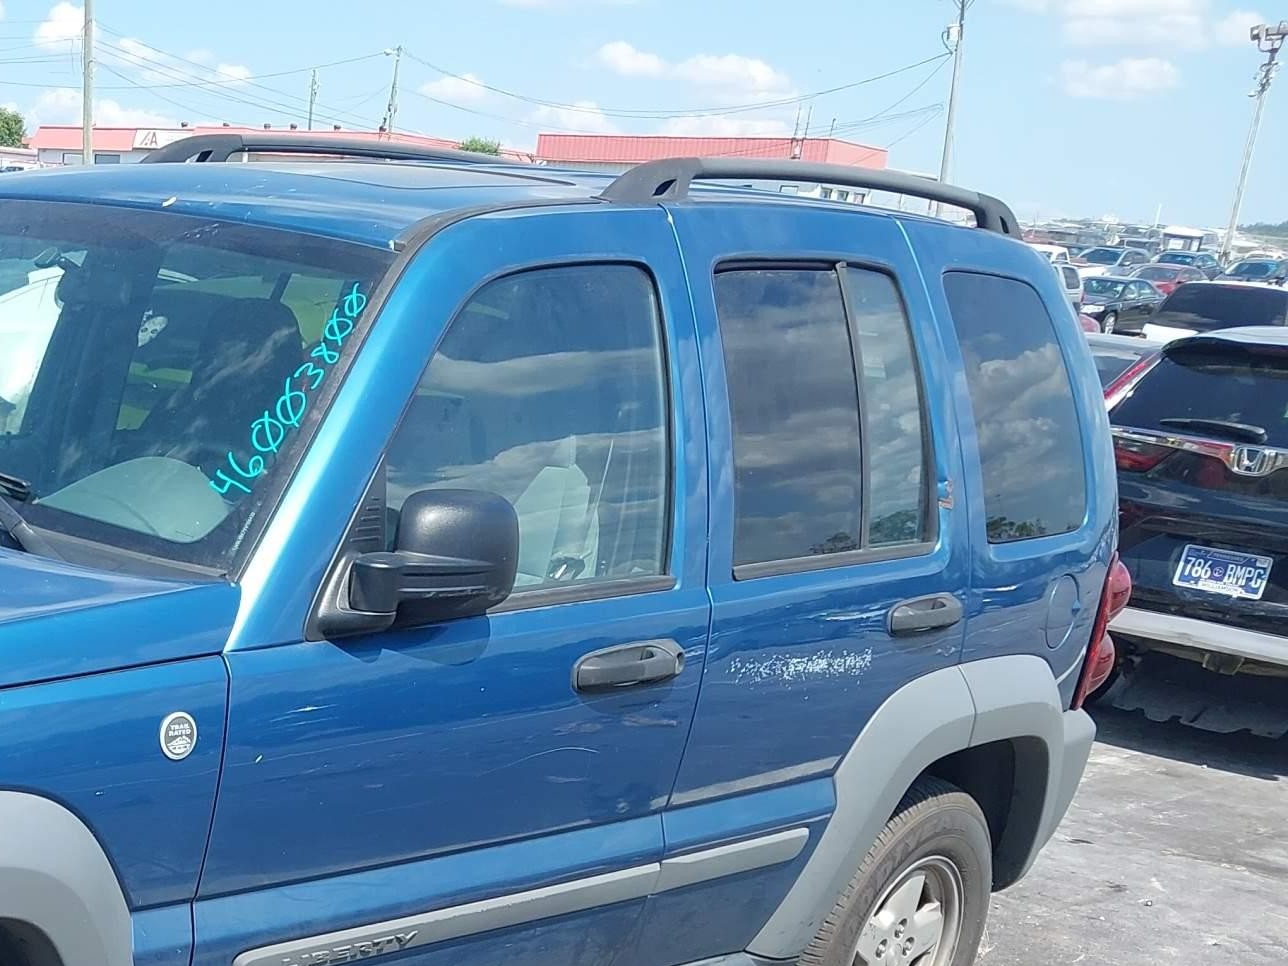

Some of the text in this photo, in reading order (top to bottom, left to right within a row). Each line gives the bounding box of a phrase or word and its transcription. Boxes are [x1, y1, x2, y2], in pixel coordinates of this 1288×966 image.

[1184, 557, 1212, 579] 786
[169, 723, 191, 731] TRAIL
[168, 729, 192, 737] RATED
